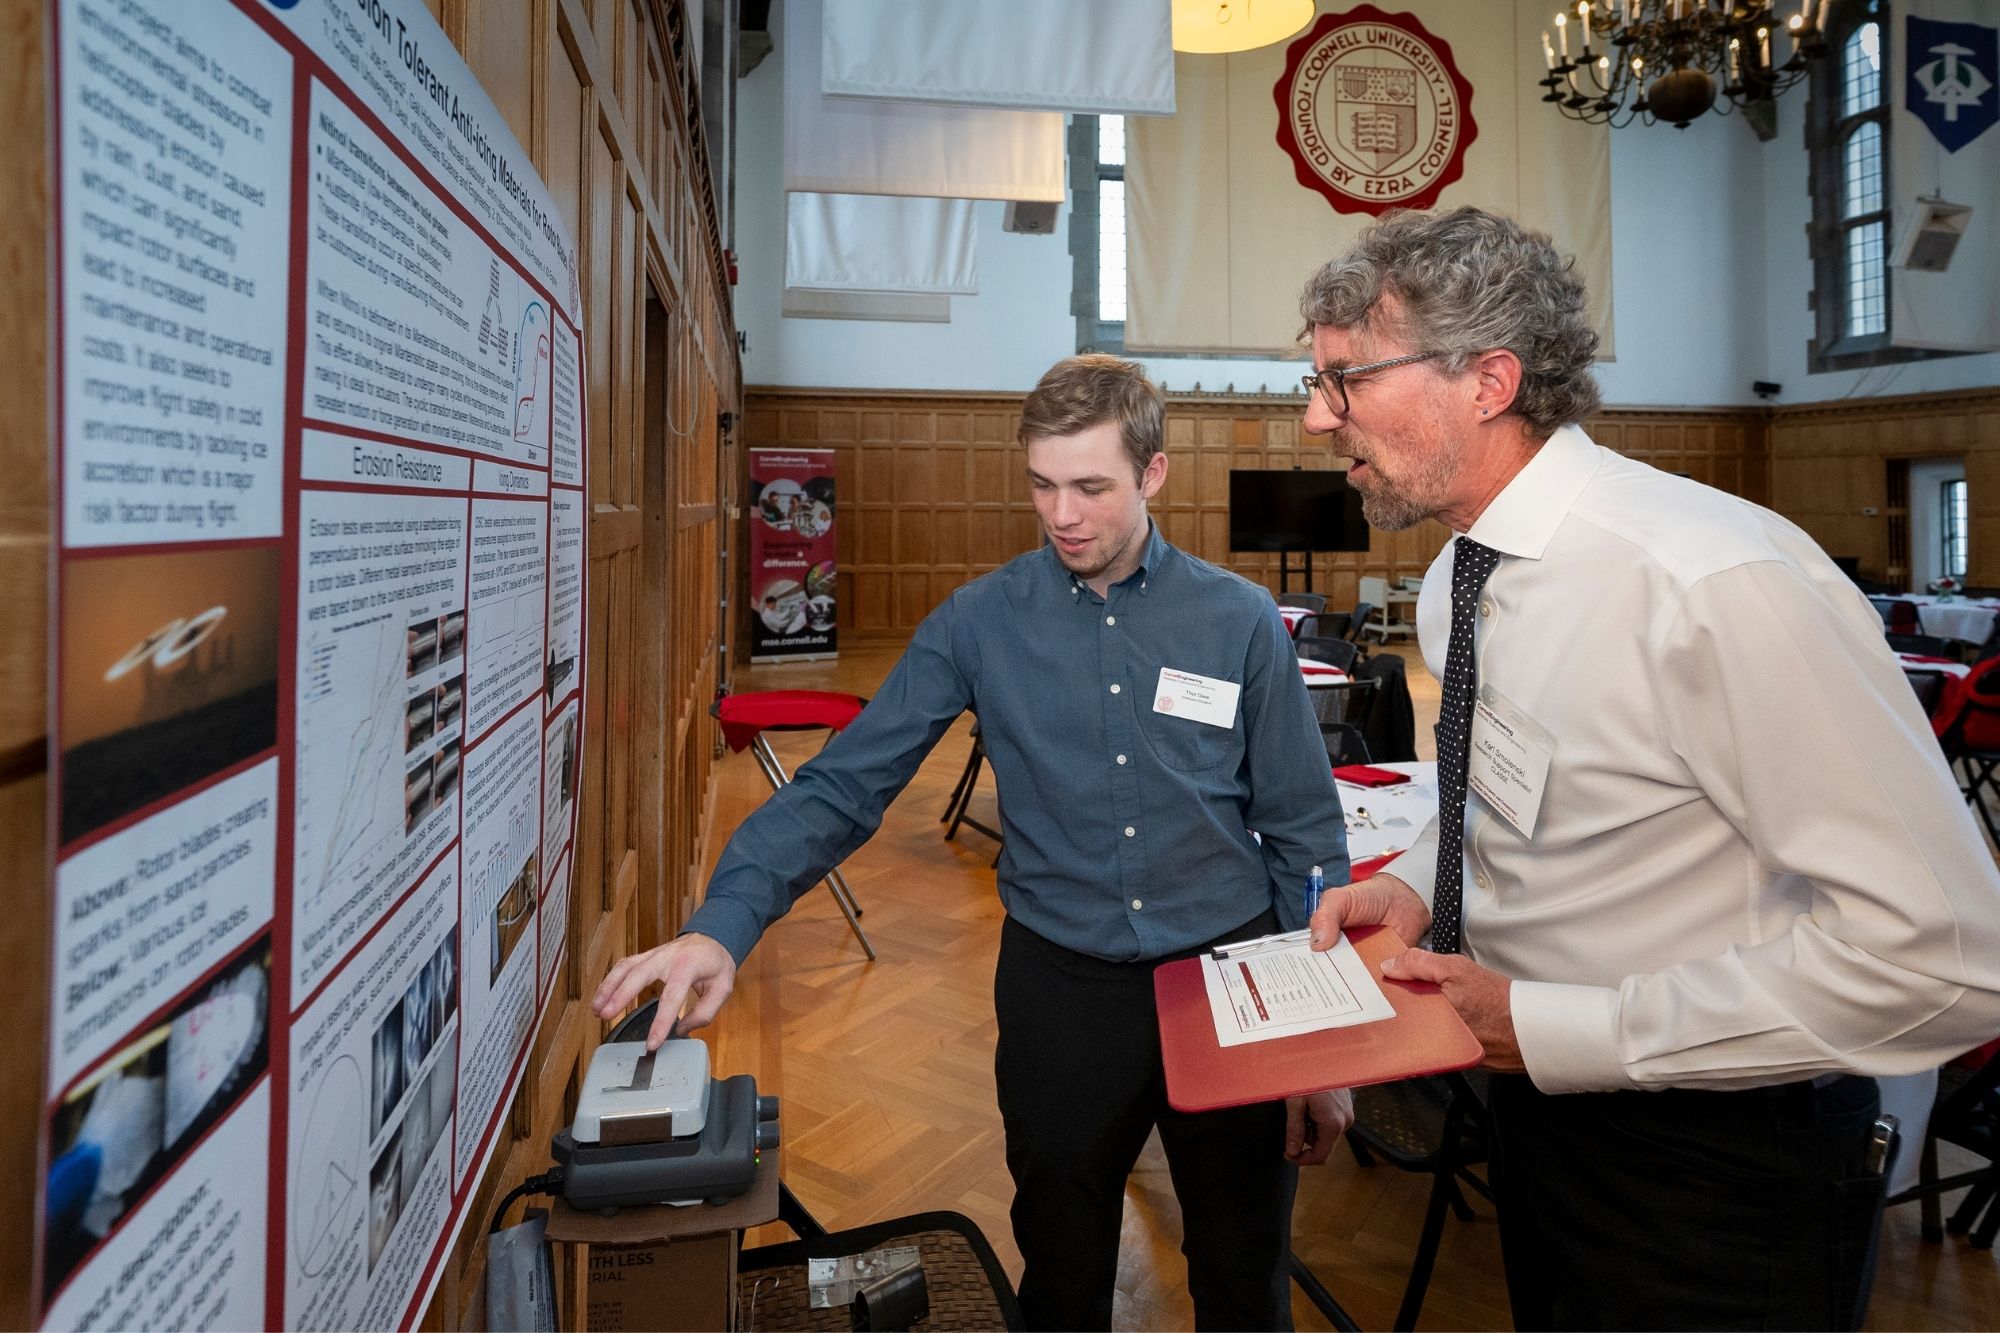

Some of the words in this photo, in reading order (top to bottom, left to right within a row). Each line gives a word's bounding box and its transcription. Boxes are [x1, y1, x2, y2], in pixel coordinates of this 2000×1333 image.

[332, 28, 360, 72] Cornell
[1305, 30, 1362, 82] CORNELL
[1366, 29, 1444, 85] UNIVERSITY
[192, 82, 250, 136] stressors
[227, 74, 272, 118] combat
[161, 93, 206, 142] blades
[396, 17, 450, 117] Tolerant
[451, 94, 497, 182] Anti-icing
[498, 155, 532, 217] Materials
[532, 200, 542, 229] for
[542, 211, 558, 248] Rotor
[318, 110, 348, 148] Nitinol
[348, 138, 386, 181] transitions
[386, 169, 410, 202] between
[1296, 89, 1330, 167] FOUNDED
[1330, 166, 1354, 186] BY
[1365, 176, 1415, 194] EZRA
[1420, 96, 1453, 177] CORNELL
[170, 140, 218, 180] erosion
[222, 171, 266, 208] caused
[326, 145, 366, 190] Martensite
[182, 181, 208, 210] and
[326, 174, 360, 213] Austenite
[164, 207, 238, 264] significantly
[340, 214, 378, 250] transitions
[176, 250, 230, 289] surfaces
[232, 275, 256, 298] and
[368, 258, 389, 285] during
[390, 271, 429, 308] manufacturing
[210, 333, 273, 367] operational
[353, 446, 394, 478] Erosion
[396, 452, 442, 483] Resistance
[510, 470, 529, 493] Dynamics
[310, 518, 340, 538] Erosion
[374, 520, 404, 534] conducted
[400, 562, 422, 581] samples
[763, 558, 810, 568] difference.
[761, 636, 828, 647] mse.cornell.edu
[1484, 738, 1496, 754] Karl
[1494, 748, 1526, 778] Smolenski
[1492, 757, 1511, 778] Support
[1510, 772, 1532, 795] Specialist
[224, 797, 269, 835] creating
[207, 903, 250, 947] blades
[618, 1252, 655, 1268] LESS
